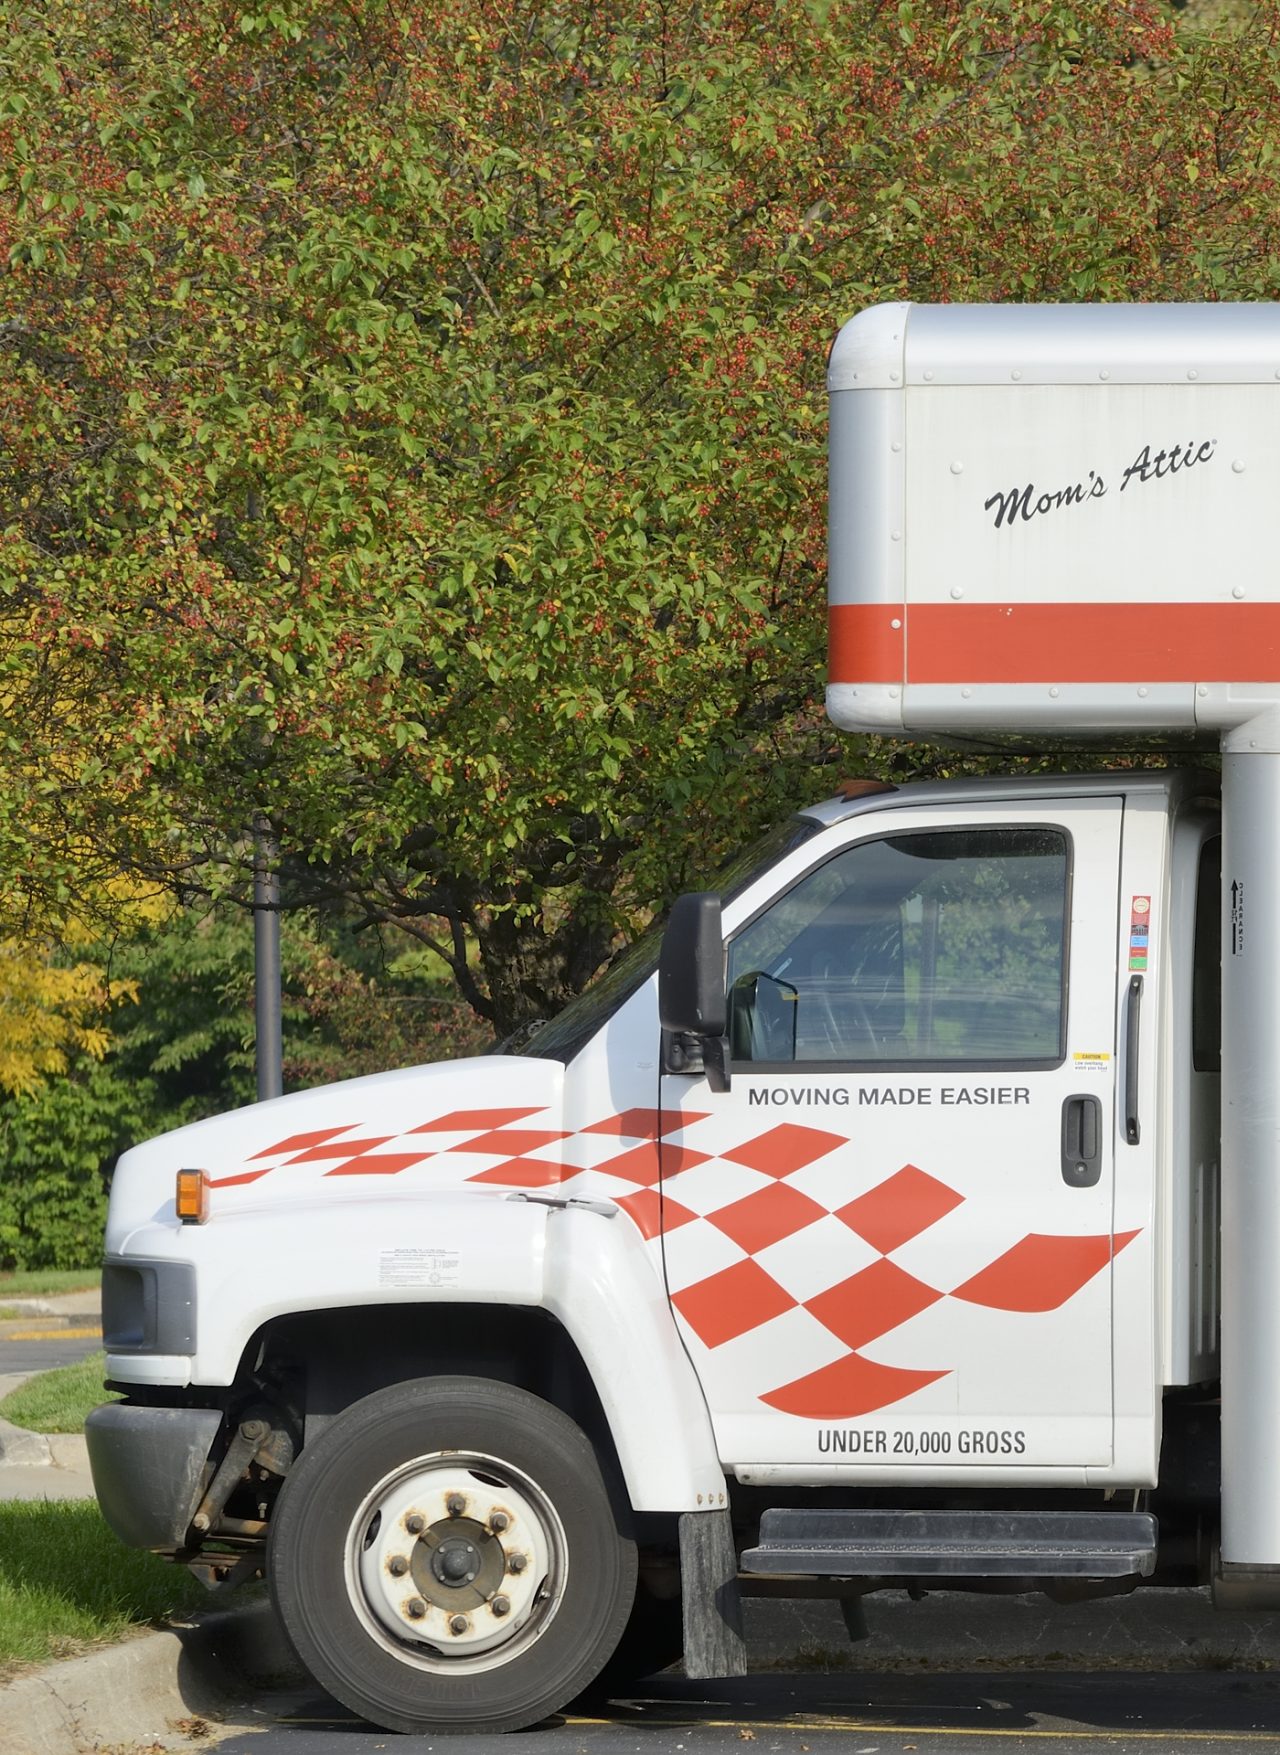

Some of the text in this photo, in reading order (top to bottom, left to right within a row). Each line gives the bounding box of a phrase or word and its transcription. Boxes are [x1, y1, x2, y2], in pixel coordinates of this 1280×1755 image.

[985, 440, 1214, 528] Mom's Attic
[749, 1087, 1030, 1105] MOVING MADE EASIER
[818, 1430, 1026, 1456] UNDER 20,000 GROSS
